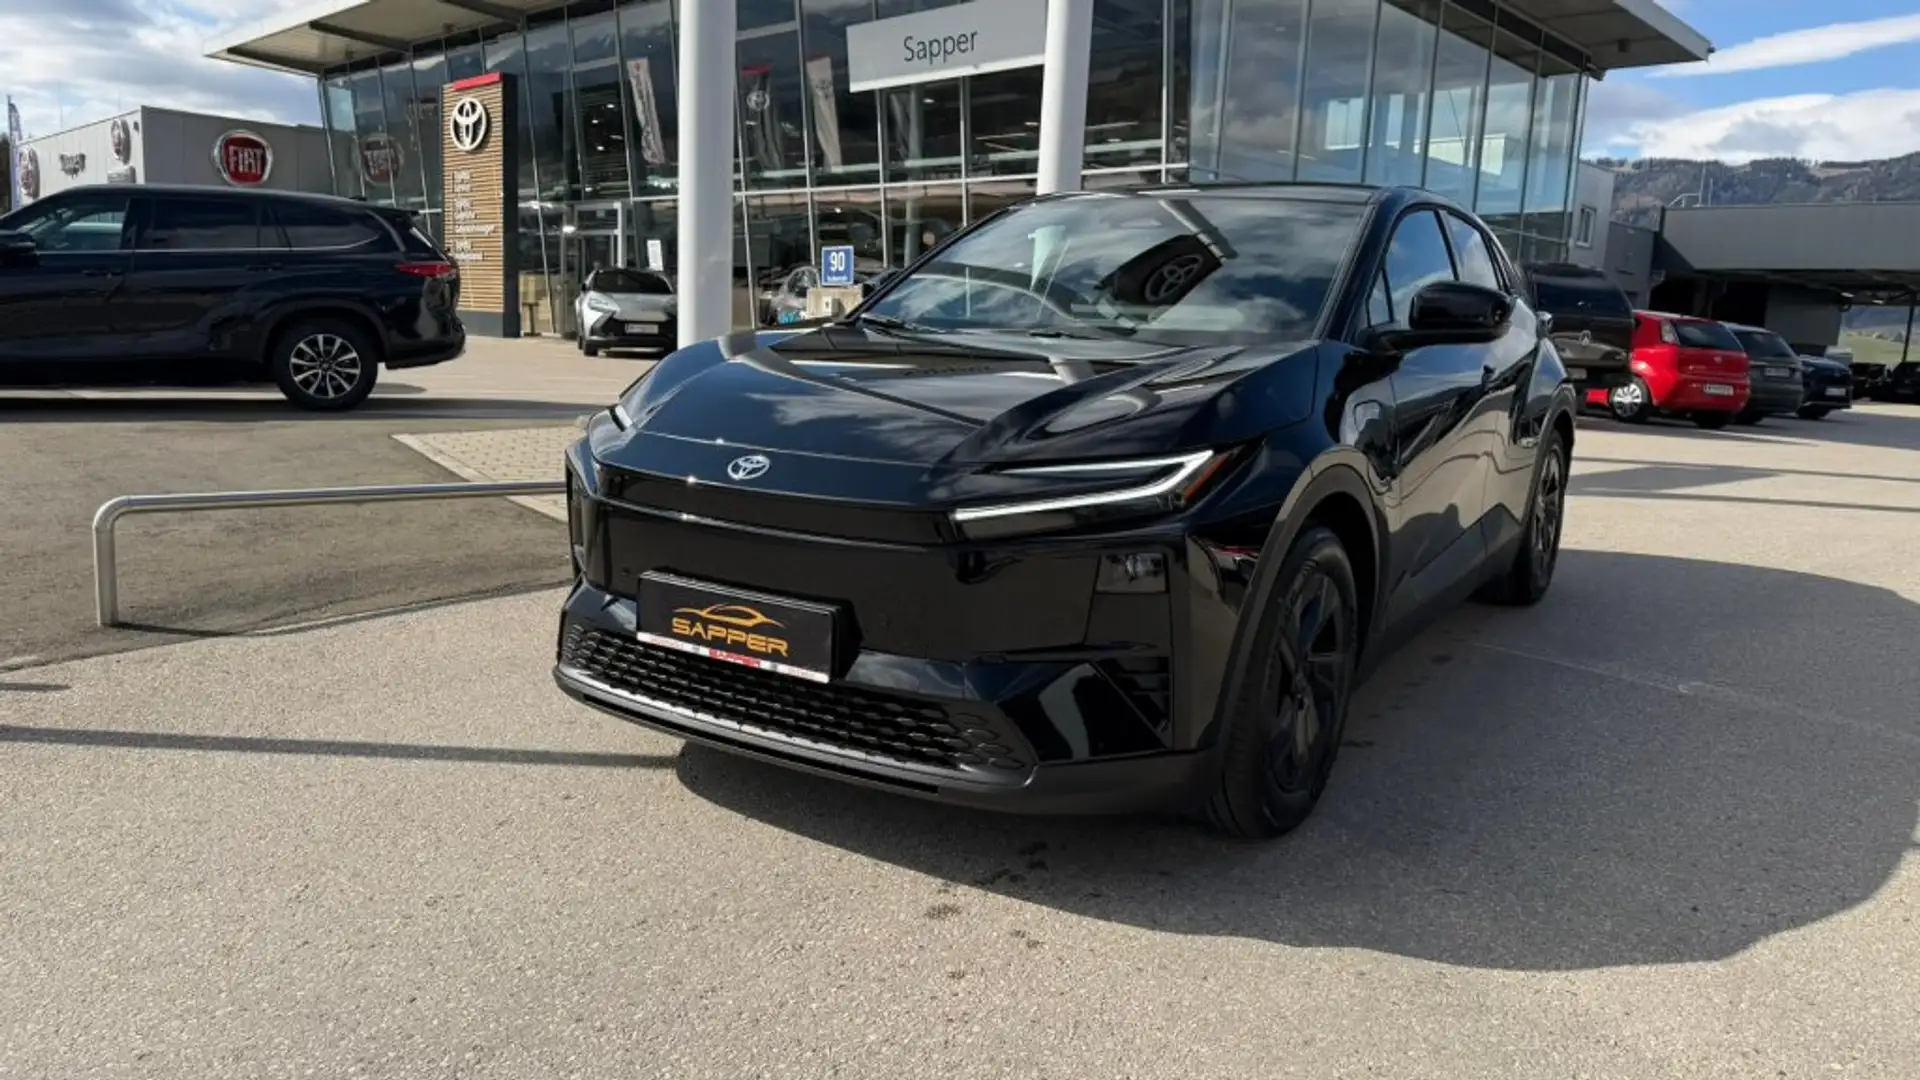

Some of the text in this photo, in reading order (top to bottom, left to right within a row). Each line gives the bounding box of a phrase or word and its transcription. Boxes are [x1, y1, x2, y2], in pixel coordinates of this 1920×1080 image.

[903, 30, 978, 64] Sapper
[228, 145, 263, 175] FIAT
[830, 251, 845, 272] 90
[671, 617, 788, 657] SAPPER
